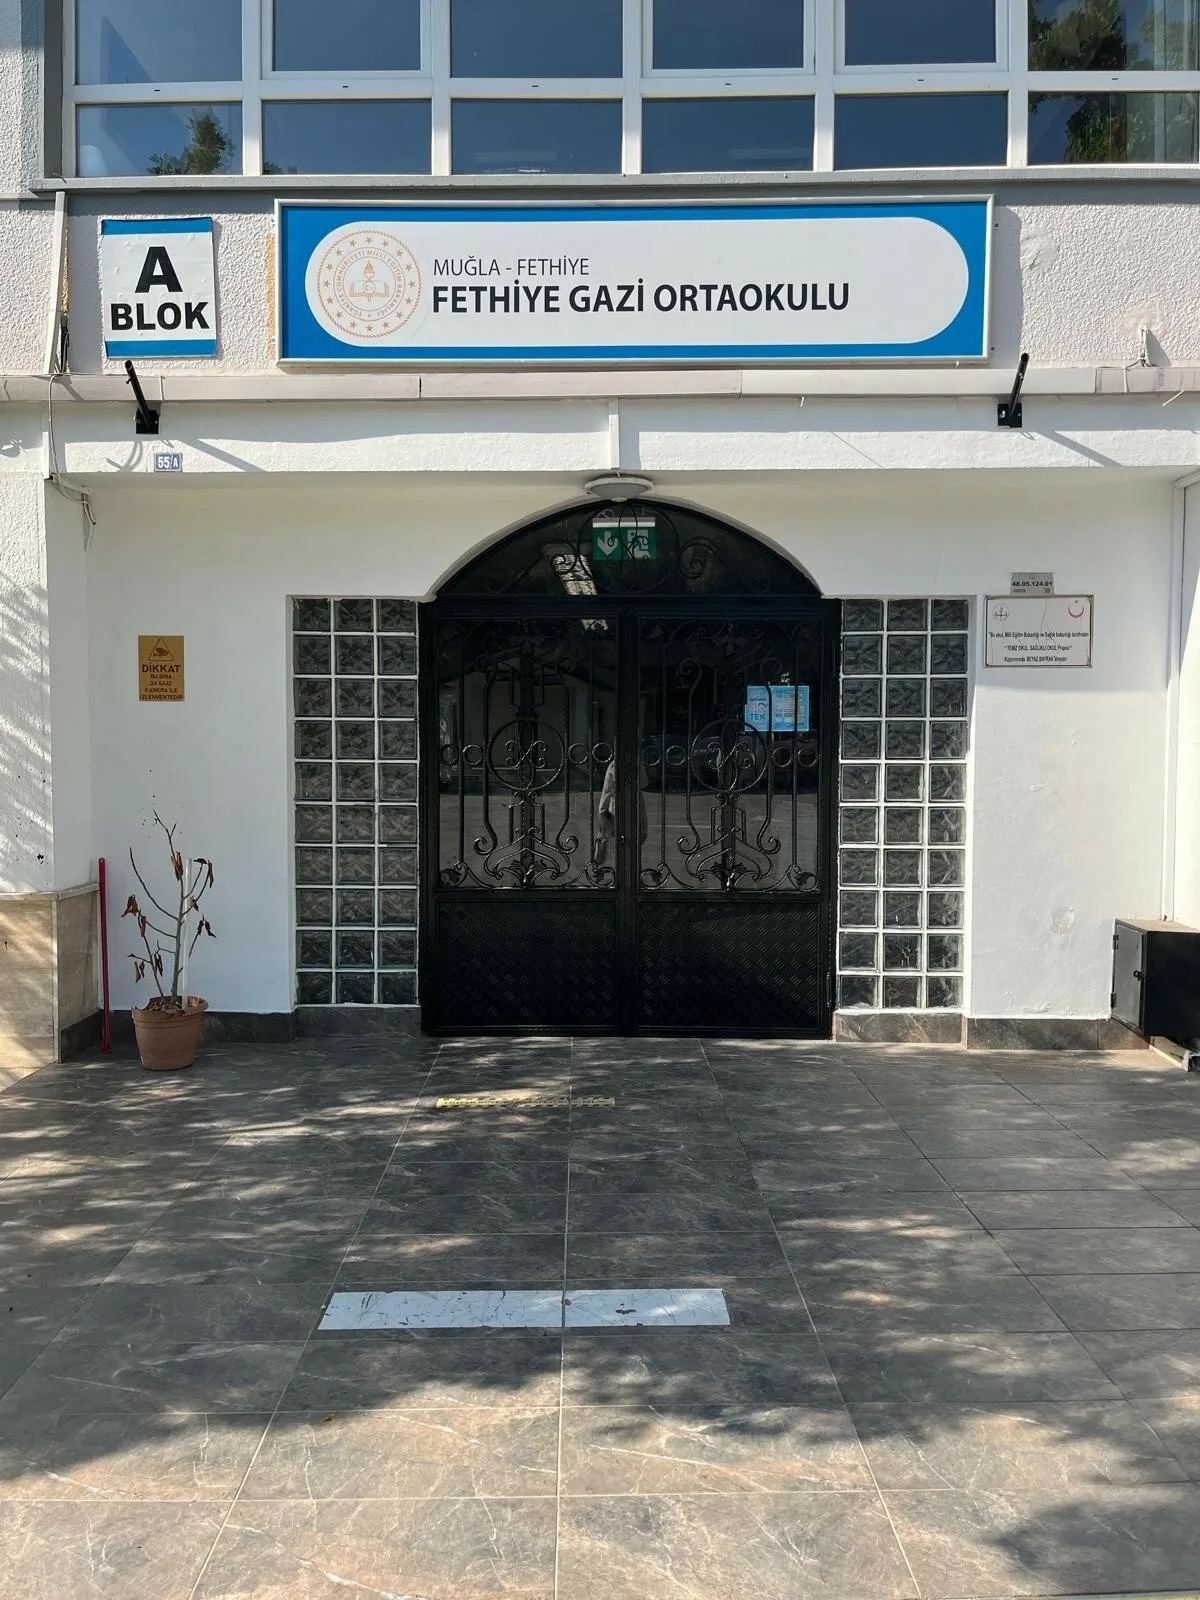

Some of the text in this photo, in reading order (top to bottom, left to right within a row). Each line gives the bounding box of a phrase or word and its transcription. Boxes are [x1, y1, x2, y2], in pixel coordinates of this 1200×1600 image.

[135, 246, 183, 293] A
[433, 256, 501, 276] MUĞLA
[517, 256, 590, 276] FETHİYE
[433, 278, 849, 313] FETHİYE GAZİ ORTAOKULU
[111, 302, 210, 330] BLOK
[157, 455, 179, 469] 55/A
[142, 662, 180, 673] DİKKAT
